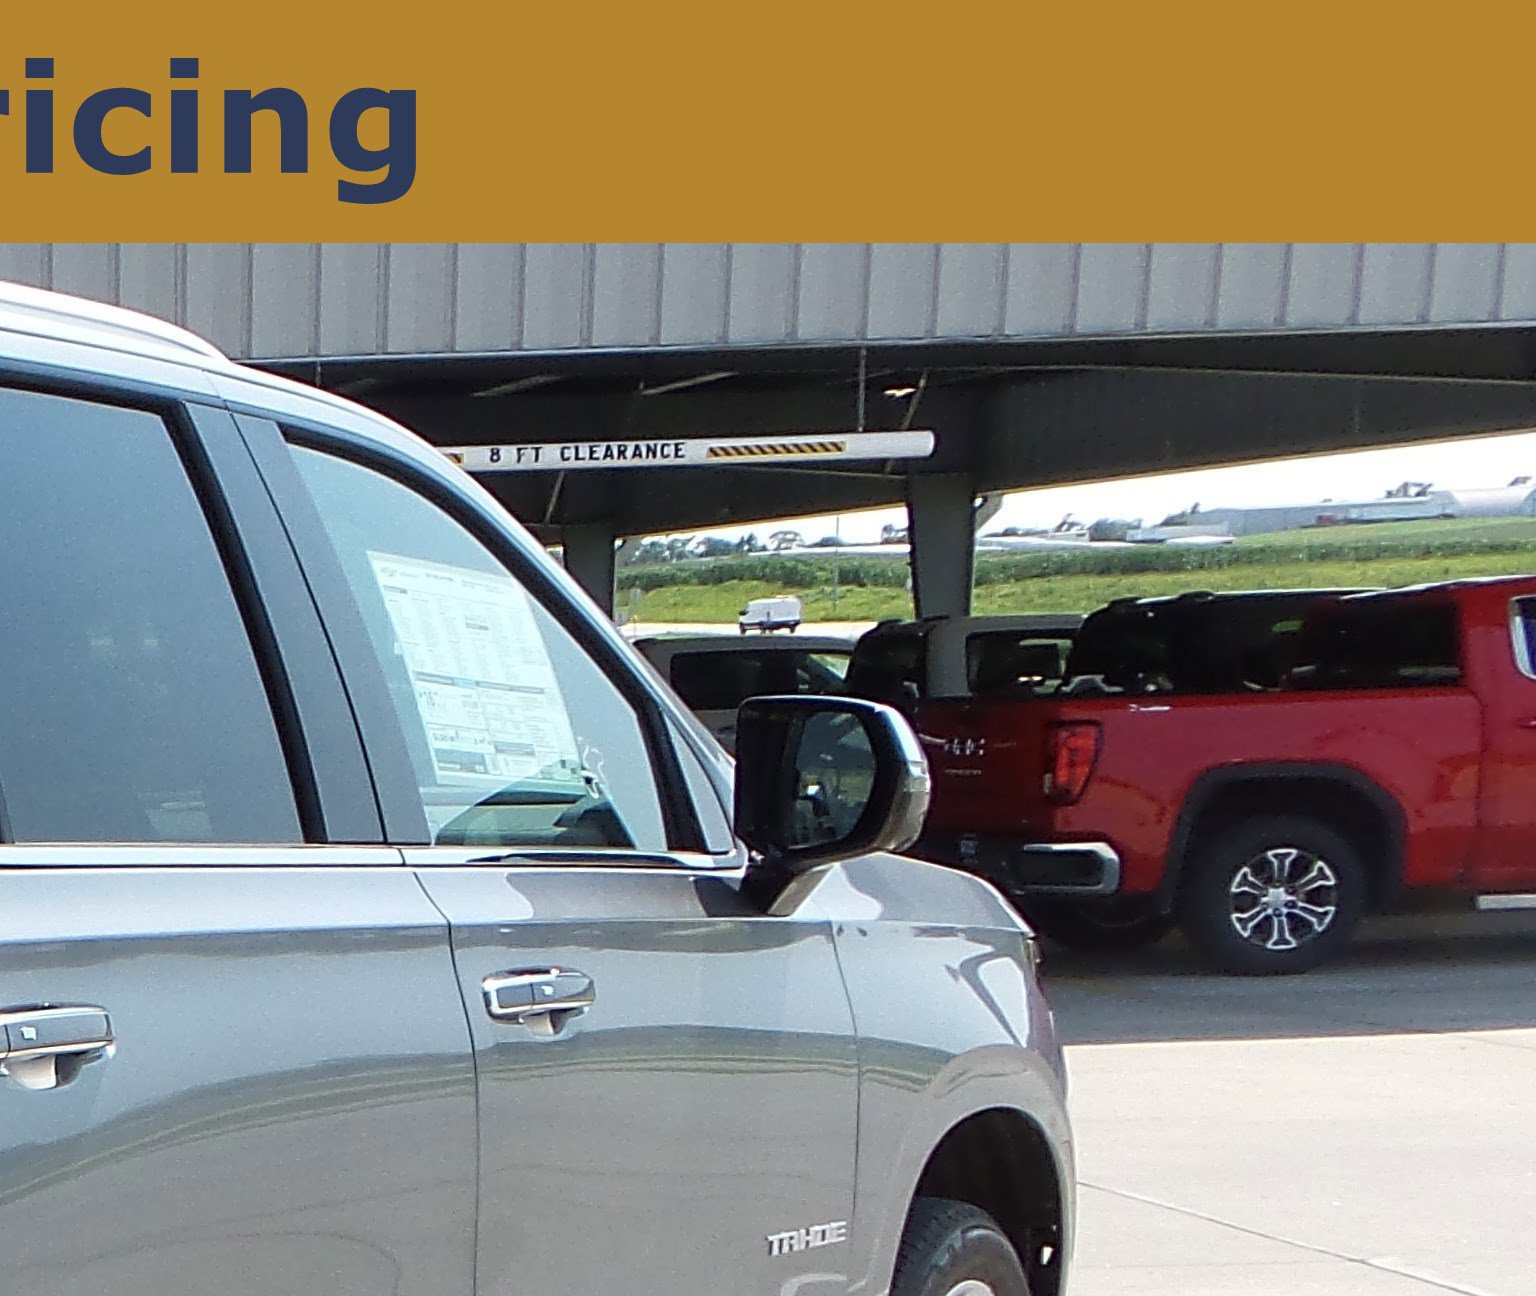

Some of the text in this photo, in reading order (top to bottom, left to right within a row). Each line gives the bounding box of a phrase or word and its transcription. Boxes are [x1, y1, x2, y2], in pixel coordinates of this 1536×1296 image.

[489, 441, 686, 464] 8 FT CLEARANCE
[766, 1221, 847, 1256] TAHOE
